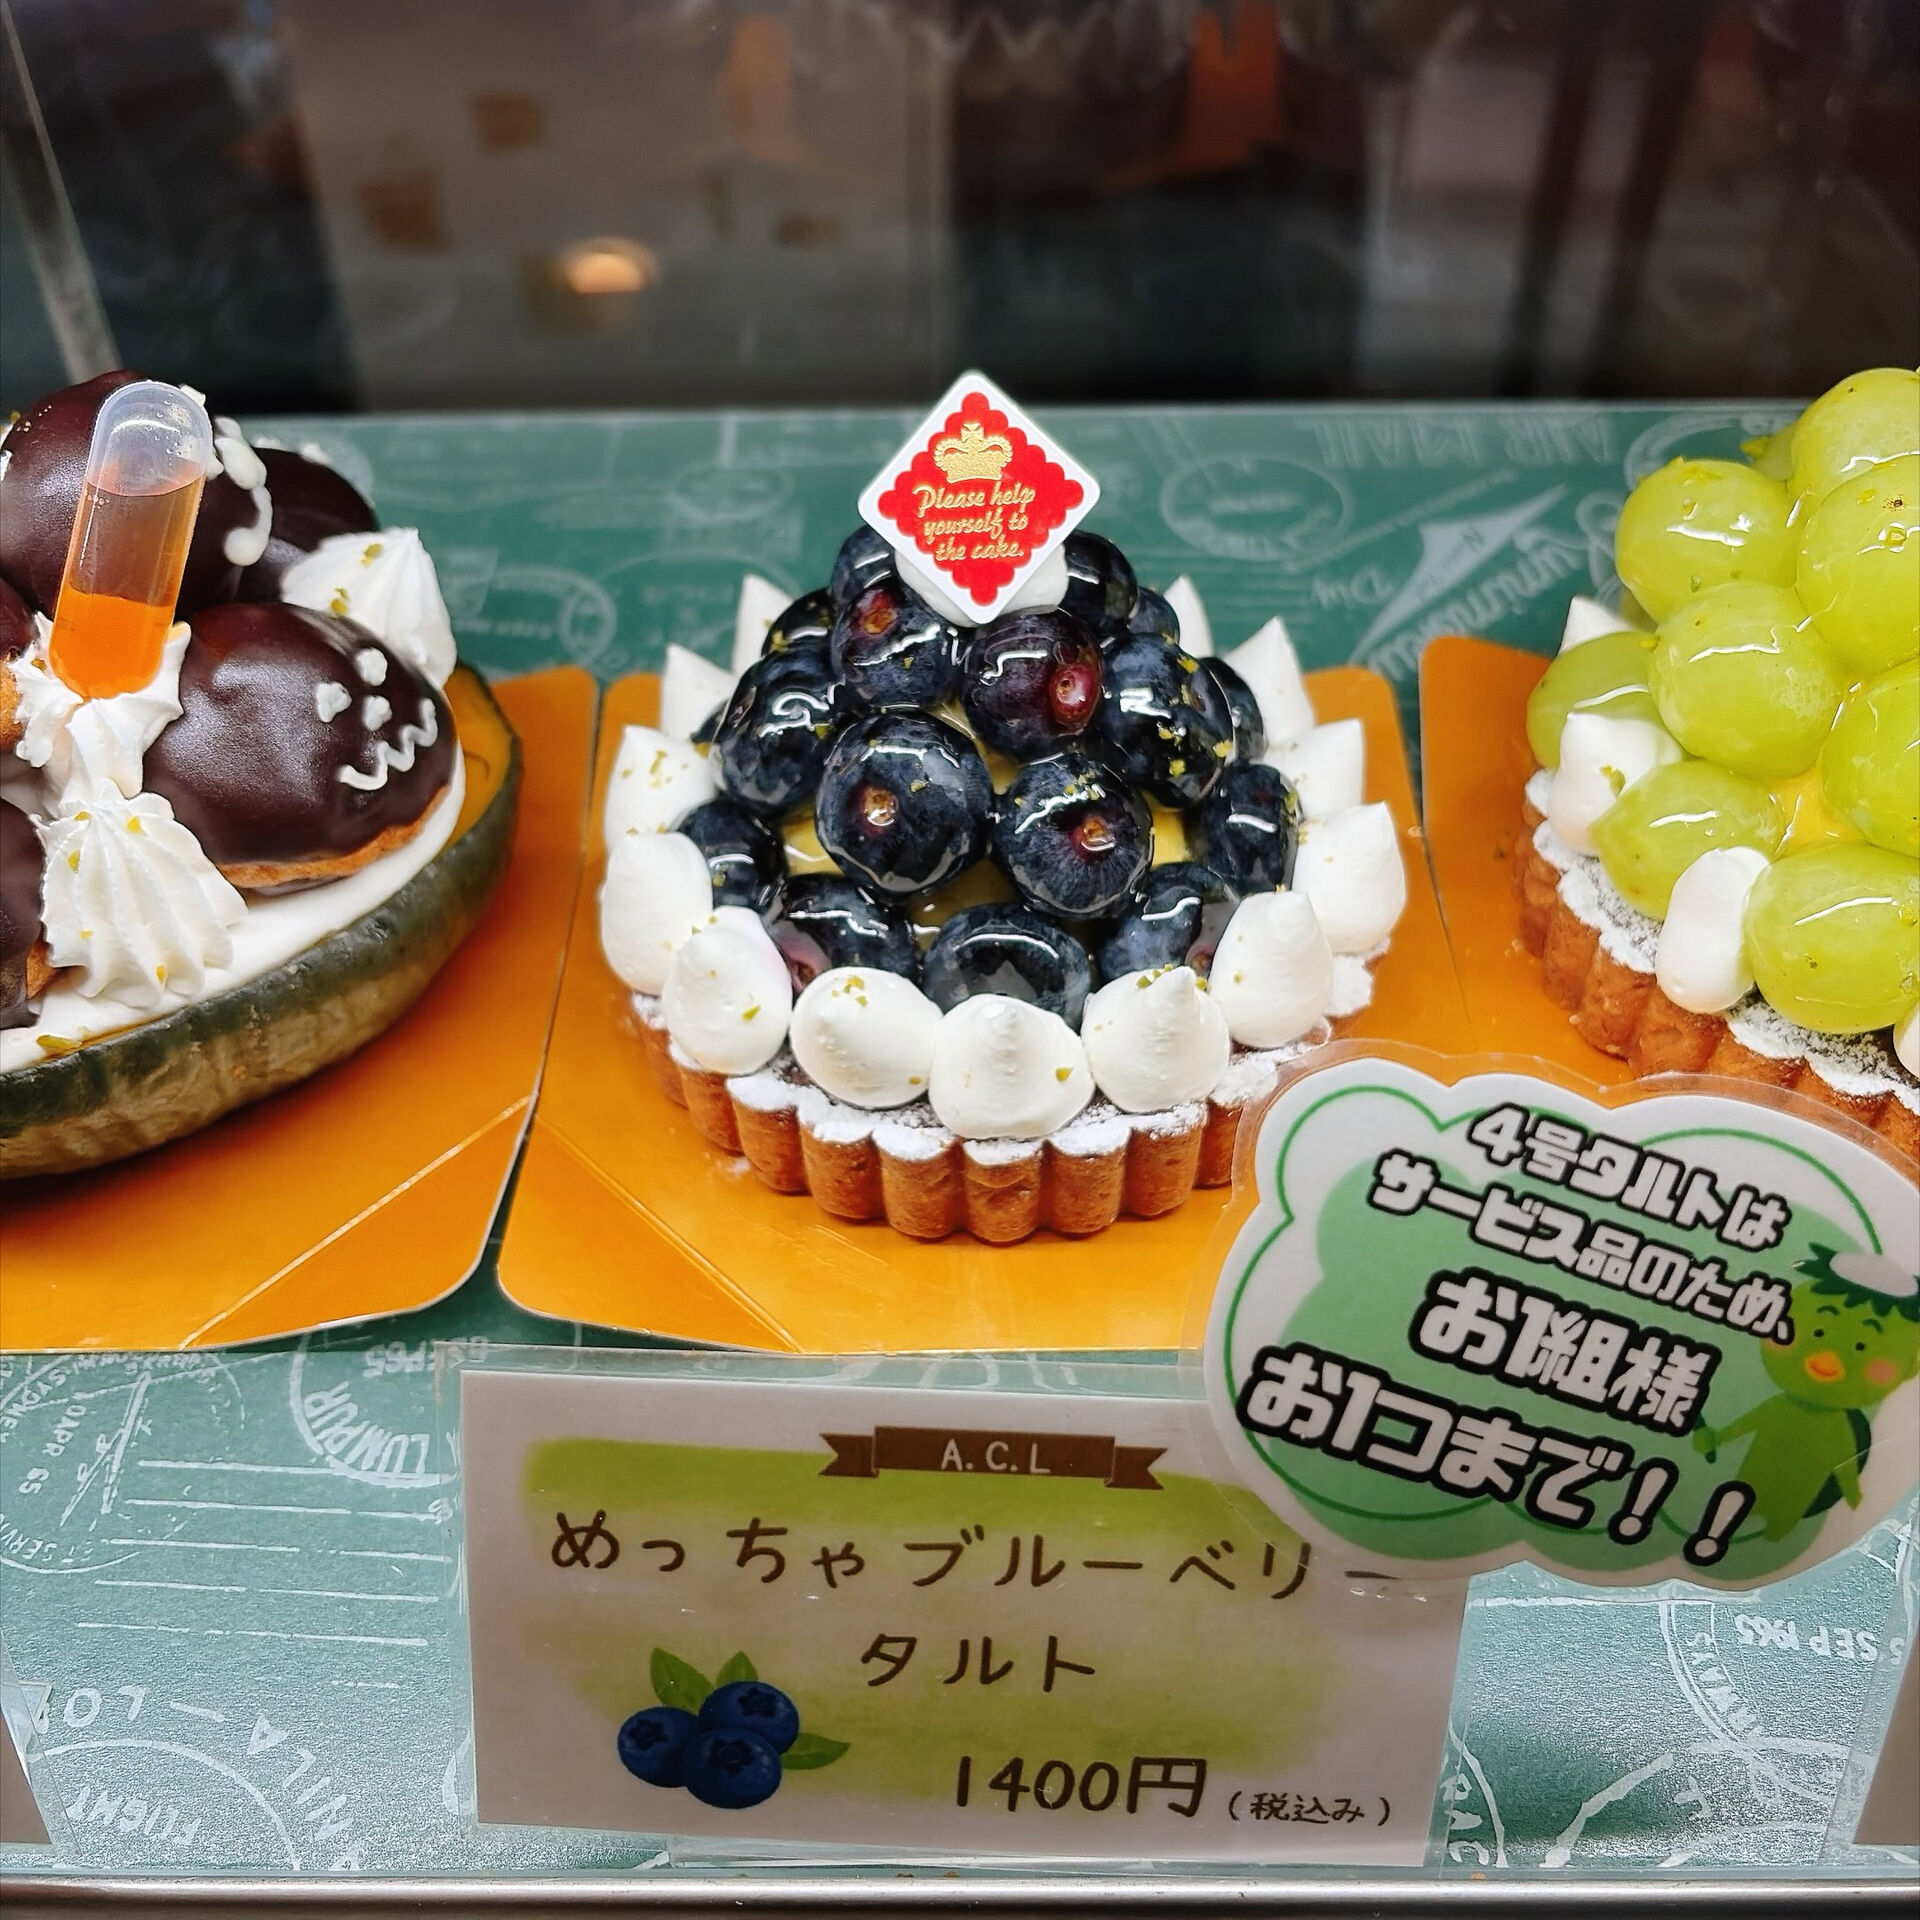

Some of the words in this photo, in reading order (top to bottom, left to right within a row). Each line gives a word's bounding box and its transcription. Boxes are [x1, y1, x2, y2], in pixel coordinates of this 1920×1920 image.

[912, 485, 986, 518] Please
[991, 481, 1036, 512] help
[924, 508, 1003, 545] yourself
[1009, 513, 1028, 531] to
[936, 540, 966, 561] the
[971, 537, 1024, 560] cake.
[1469, 1105, 1790, 1250] 4号タルトは
[1370, 1150, 1794, 1343] サービス品のため、
[1411, 1269, 1721, 1436] お1組様
[304, 1381, 430, 1474] LUMPUR
[551, 1508, 1401, 1600] めっちゃブルーベリー
[861, 1633, 1095, 1692] タルト
[1810, 1625, 1878, 1661] SEP
[956, 1755, 1207, 1817] 1400円
